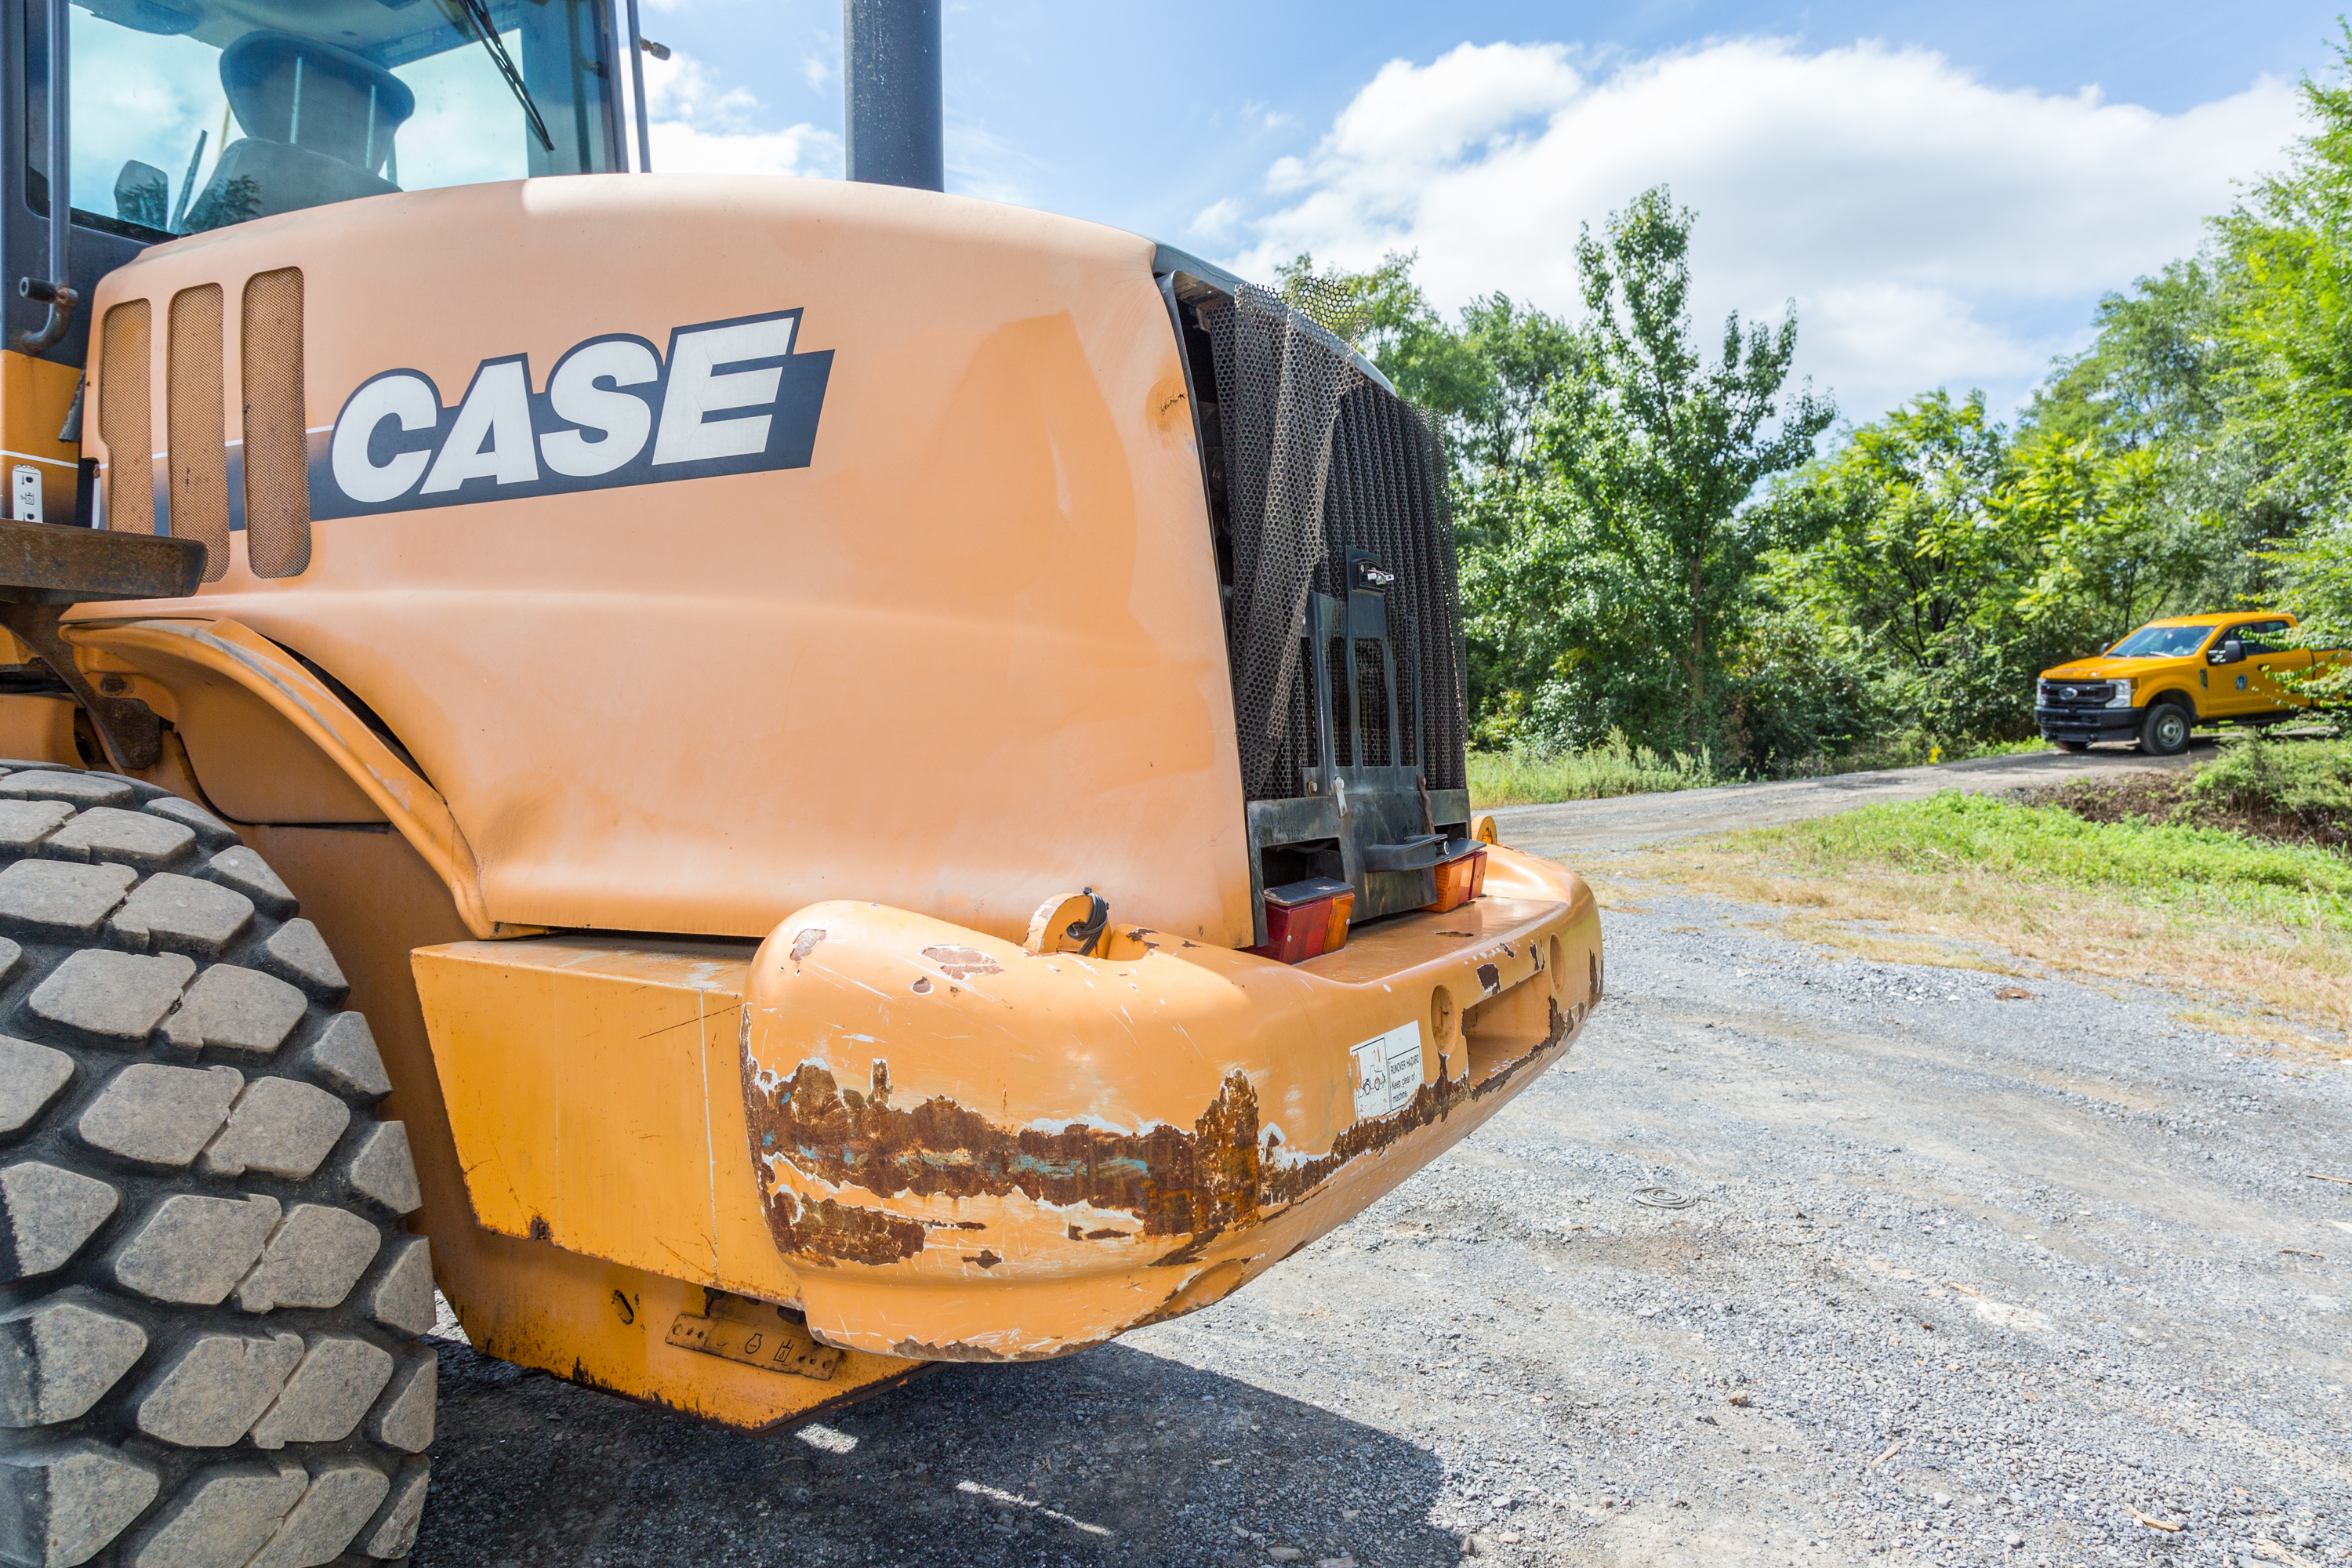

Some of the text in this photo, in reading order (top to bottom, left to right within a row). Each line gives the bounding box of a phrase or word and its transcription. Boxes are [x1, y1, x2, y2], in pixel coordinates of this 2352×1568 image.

[332, 317, 794, 503] CASE
[1390, 1054, 1419, 1075] RUNOVER HAZARD
[1392, 1071, 1415, 1091] Keep clear of
